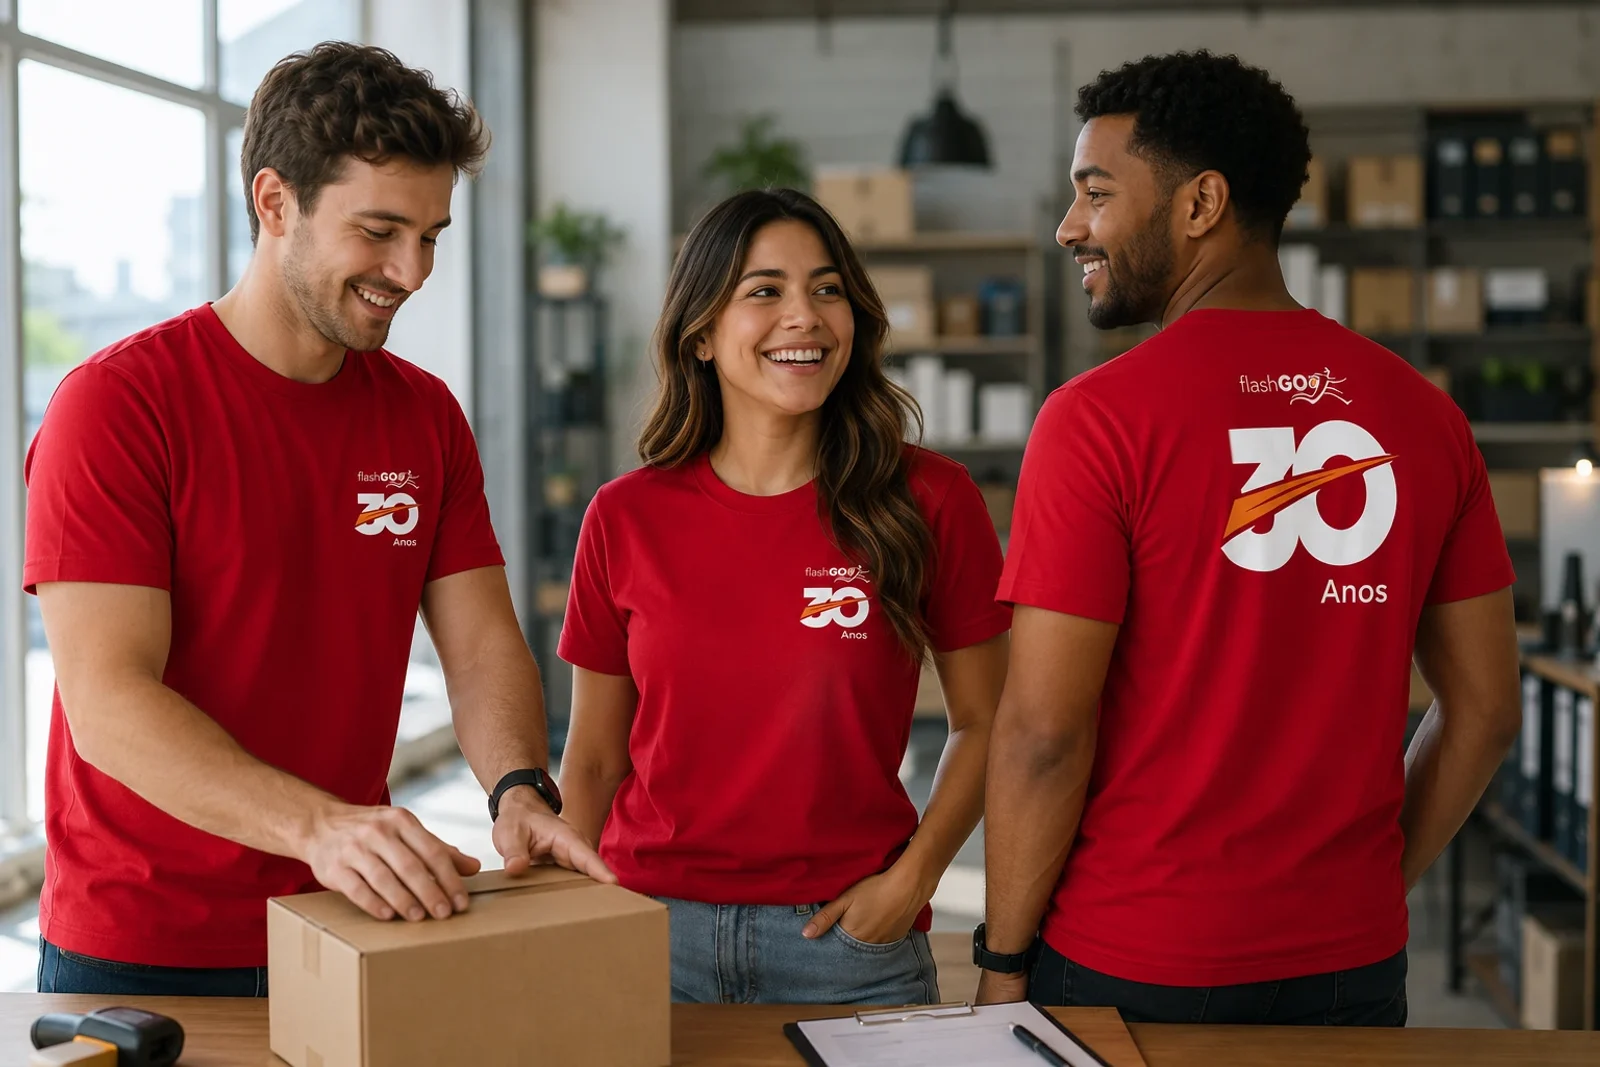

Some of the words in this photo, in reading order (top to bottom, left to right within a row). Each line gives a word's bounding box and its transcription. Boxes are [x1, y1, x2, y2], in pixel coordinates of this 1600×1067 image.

[1221, 420, 1397, 572] 30
[354, 492, 419, 536] 30
[392, 538, 417, 547] Anos
[800, 586, 869, 628] 30
[1320, 579, 1388, 604] Anos
[840, 630, 868, 640] Anos
